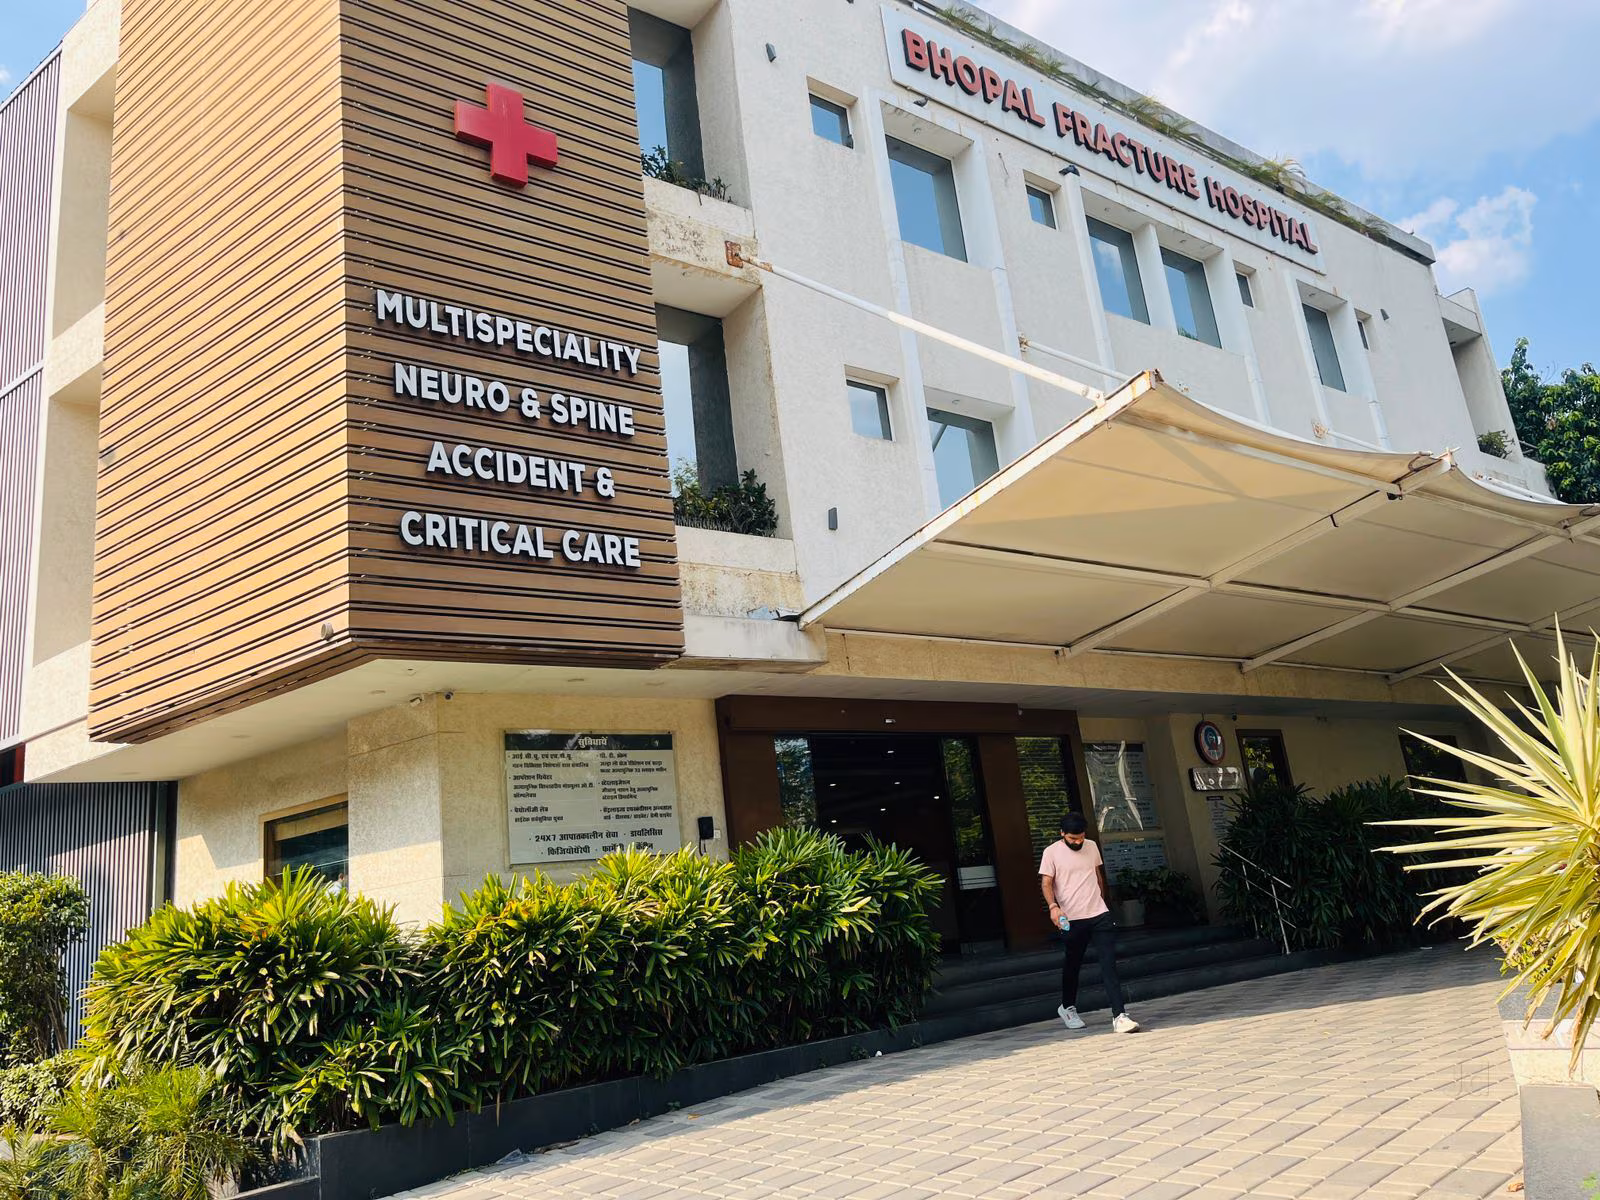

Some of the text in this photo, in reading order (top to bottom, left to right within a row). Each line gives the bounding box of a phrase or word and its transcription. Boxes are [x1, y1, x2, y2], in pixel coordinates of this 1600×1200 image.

[901, 28, 1318, 254] BHOPAL FRACTURE HOSPITAL
[375, 289, 642, 375] MULTISPECIALITY
[393, 362, 635, 436] NEURO & SPINE
[427, 441, 615, 499] ACCIDENT &
[400, 511, 641, 568] CRITICAL CARE
[559, 830, 604, 841] आपातकालीन
[605, 829, 618, 839] सेवा
[630, 828, 663, 837] डायलिसिस
